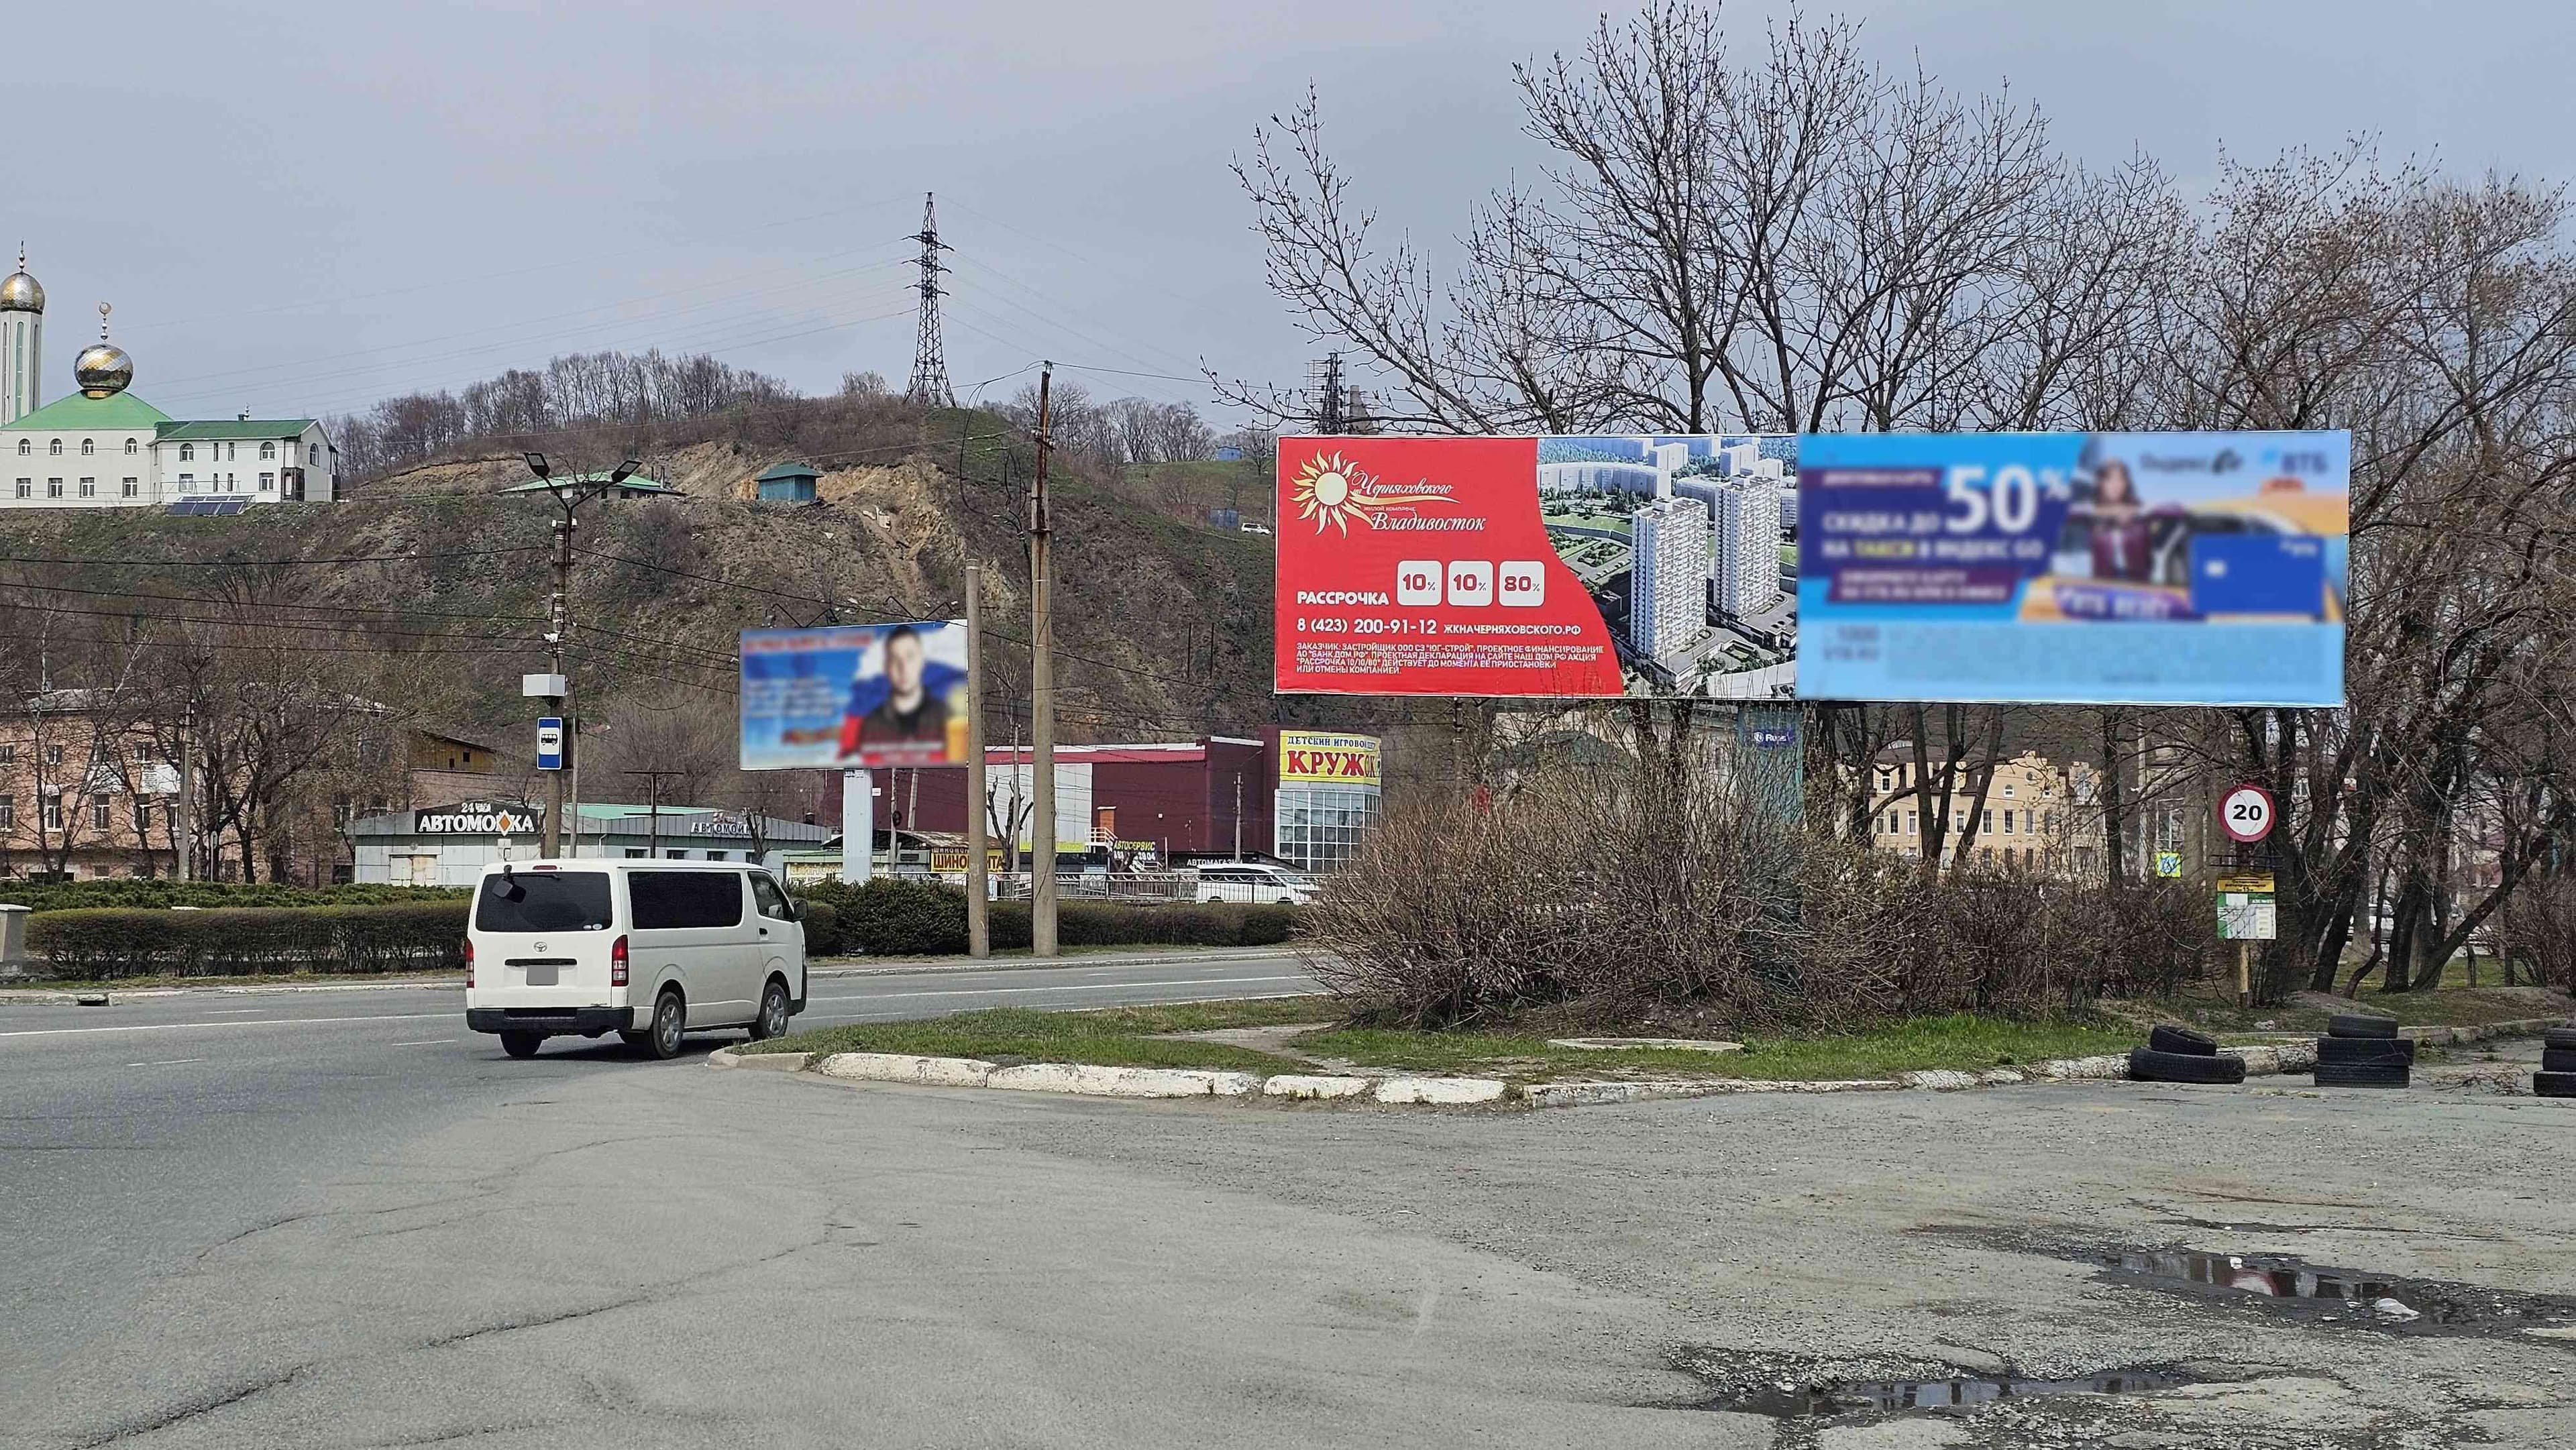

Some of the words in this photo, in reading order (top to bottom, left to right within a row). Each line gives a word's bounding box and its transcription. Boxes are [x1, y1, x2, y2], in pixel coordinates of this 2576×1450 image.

[1371, 512, 1487, 531] Владивосток
[1403, 573, 1436, 592] 10%
[1454, 573, 1487, 592] 10%
[1504, 575, 1540, 592] 80%
[1297, 591, 1389, 606] РАССРОЧКА
[1297, 618, 1305, 632] 8
[1311, 618, 1348, 634] (423)
[1354, 618, 1437, 634] 200-91-12
[1444, 624, 1581, 636] ЖКНАЧЕРНЯХОВСКОГО.РФ
[1342, 642, 1397, 652] ЗАСТРОЙЩИК
[1398, 644, 1413, 652] ООО
[1477, 645, 1524, 653] ПРОЕКТНОЕ
[1525, 645, 1604, 653] ФИНАНСИРОВАНИЕ
[1372, 651, 1418, 659] ПРОЕКТНАЯ
[1419, 652, 1474, 661] ДЕКЛАРАЦИЯ
[1487, 652, 1513, 661] САЙТЕ
[1514, 653, 1534, 661] НАШ
[1535, 653, 1552, 661] ДОМ
[1567, 653, 1597, 662] АКЦИЯ
[1296, 665, 1313, 673] ИЛИ
[1315, 665, 1348, 673] ОТМЕНЫ
[1350, 666, 1401, 674] КОМПАНИЕЙ.
[1382, 659, 1427, 667] ДЕЙСТВУЕТ
[1428, 659, 1439, 667] ДО
[1491, 660, 1556, 668] ПРИОСТАНОВКИ
[1287, 736, 1330, 746] ДЕТСКИЙ
[1287, 750, 1376, 778] КРУЖОК
[461, 802, 475, 813] 24
[2233, 804, 2262, 821] 20
[1114, 840, 1156, 851] АВТОСЕРВИС
[1187, 858, 1242, 867] АВТОМАГАЗ
